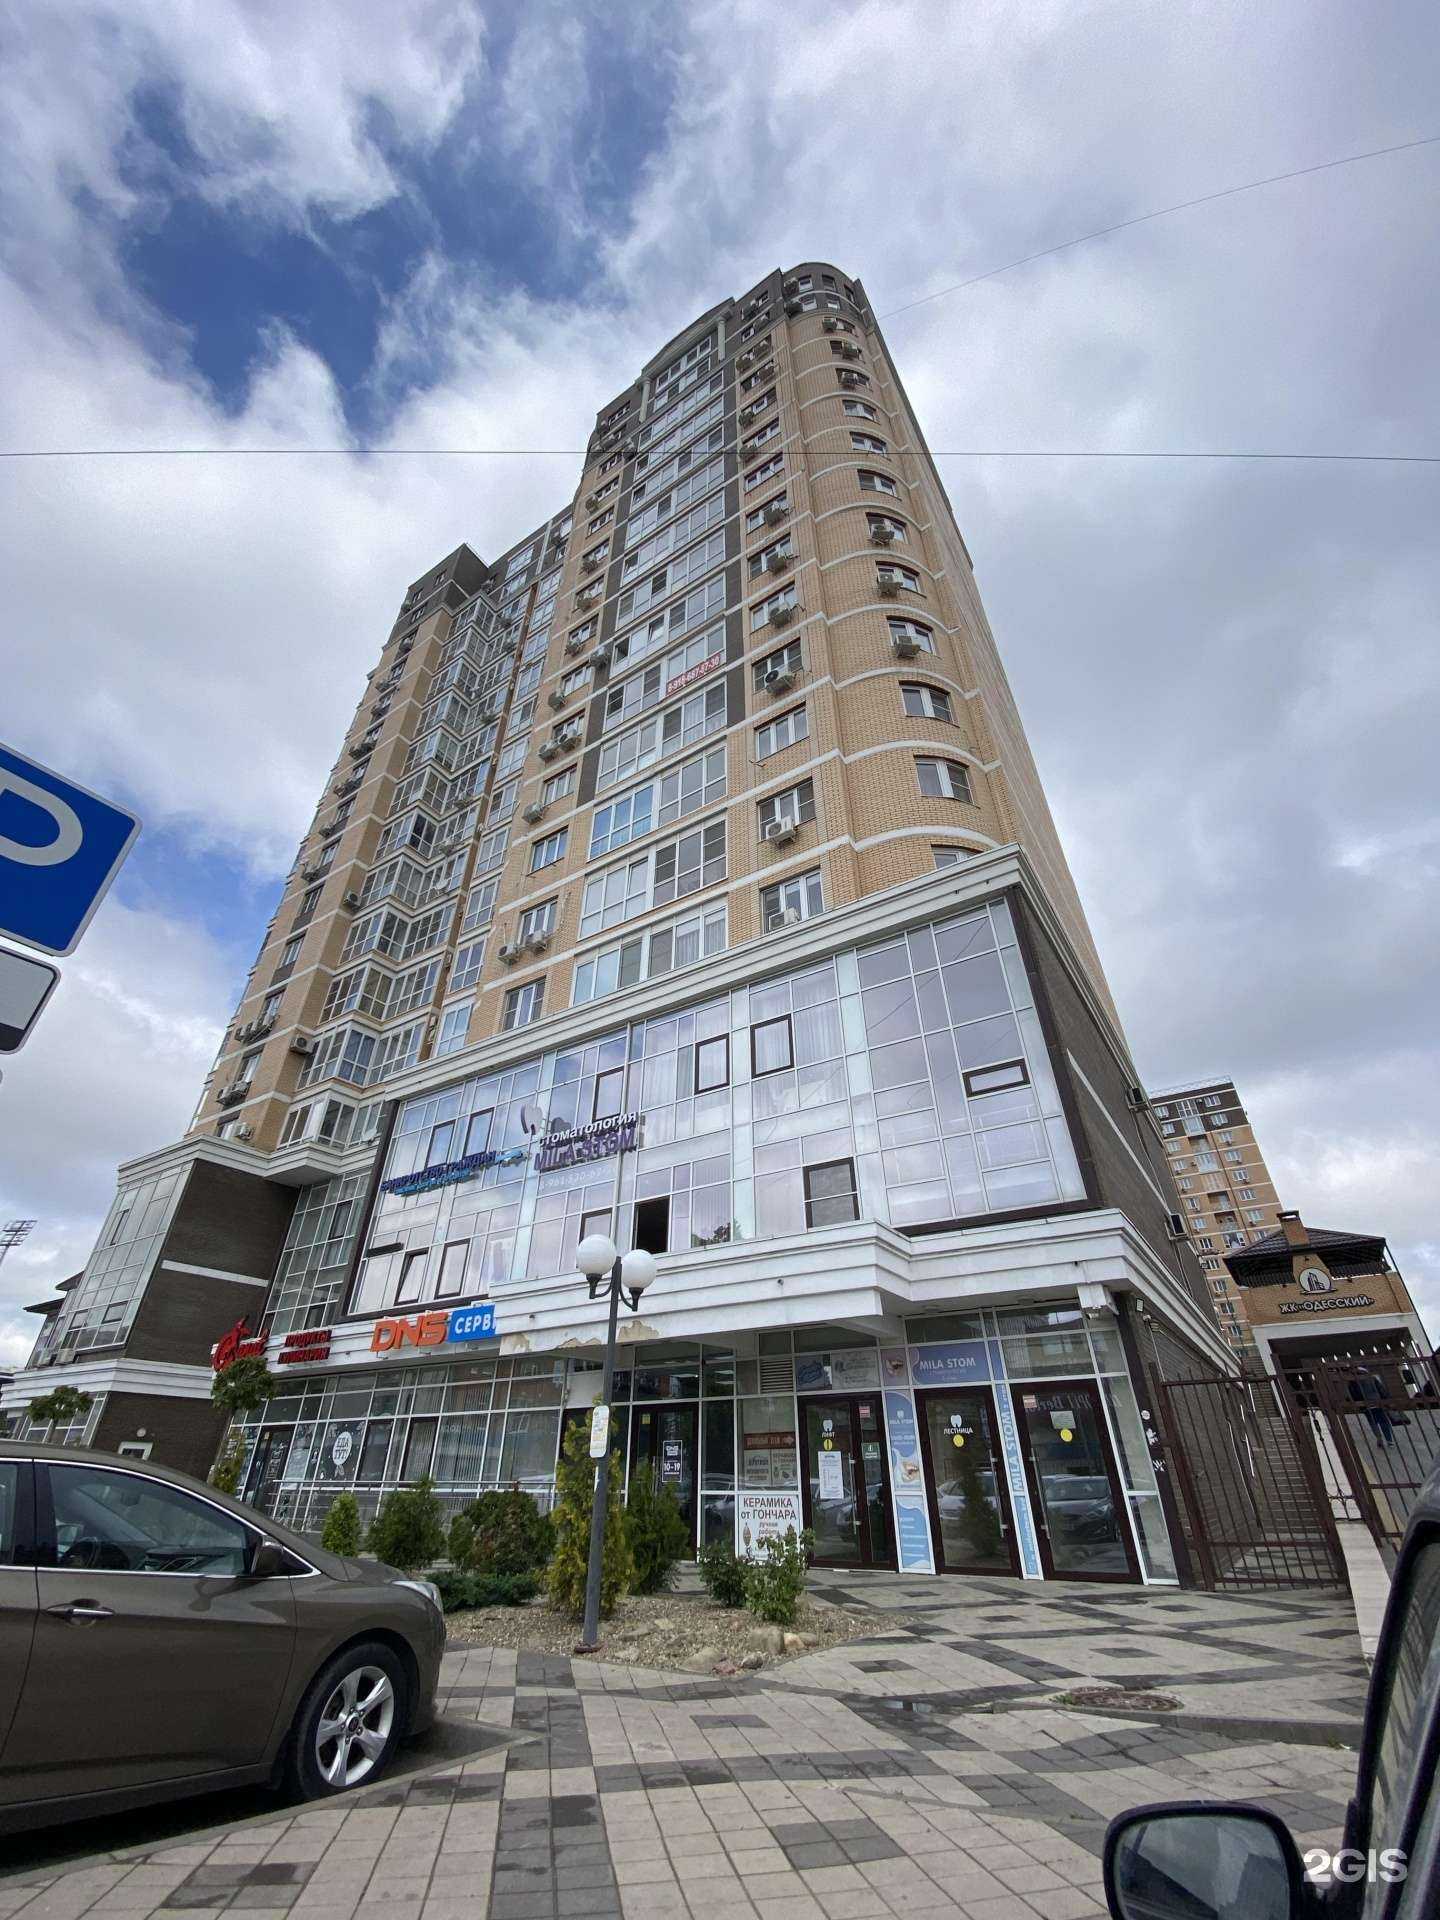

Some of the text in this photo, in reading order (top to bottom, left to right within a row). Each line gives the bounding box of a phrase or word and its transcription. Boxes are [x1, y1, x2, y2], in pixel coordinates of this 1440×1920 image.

[1280, 1303, 1297, 1313] ЖК
[454, 1313, 496, 1334] СЕРВ
[370, 1312, 450, 1351] DNS
[919, 1357, 977, 1371] MILA STOM
[943, 1426, 973, 1435] ЛЕСТНИЦА
[1001, 1411, 1016, 1450] STOM
[1009, 1456, 1024, 1491] MILA
[743, 1497, 793, 1508] КЕРАМИКА
[740, 1509, 797, 1520] от ГОНЧАРА
